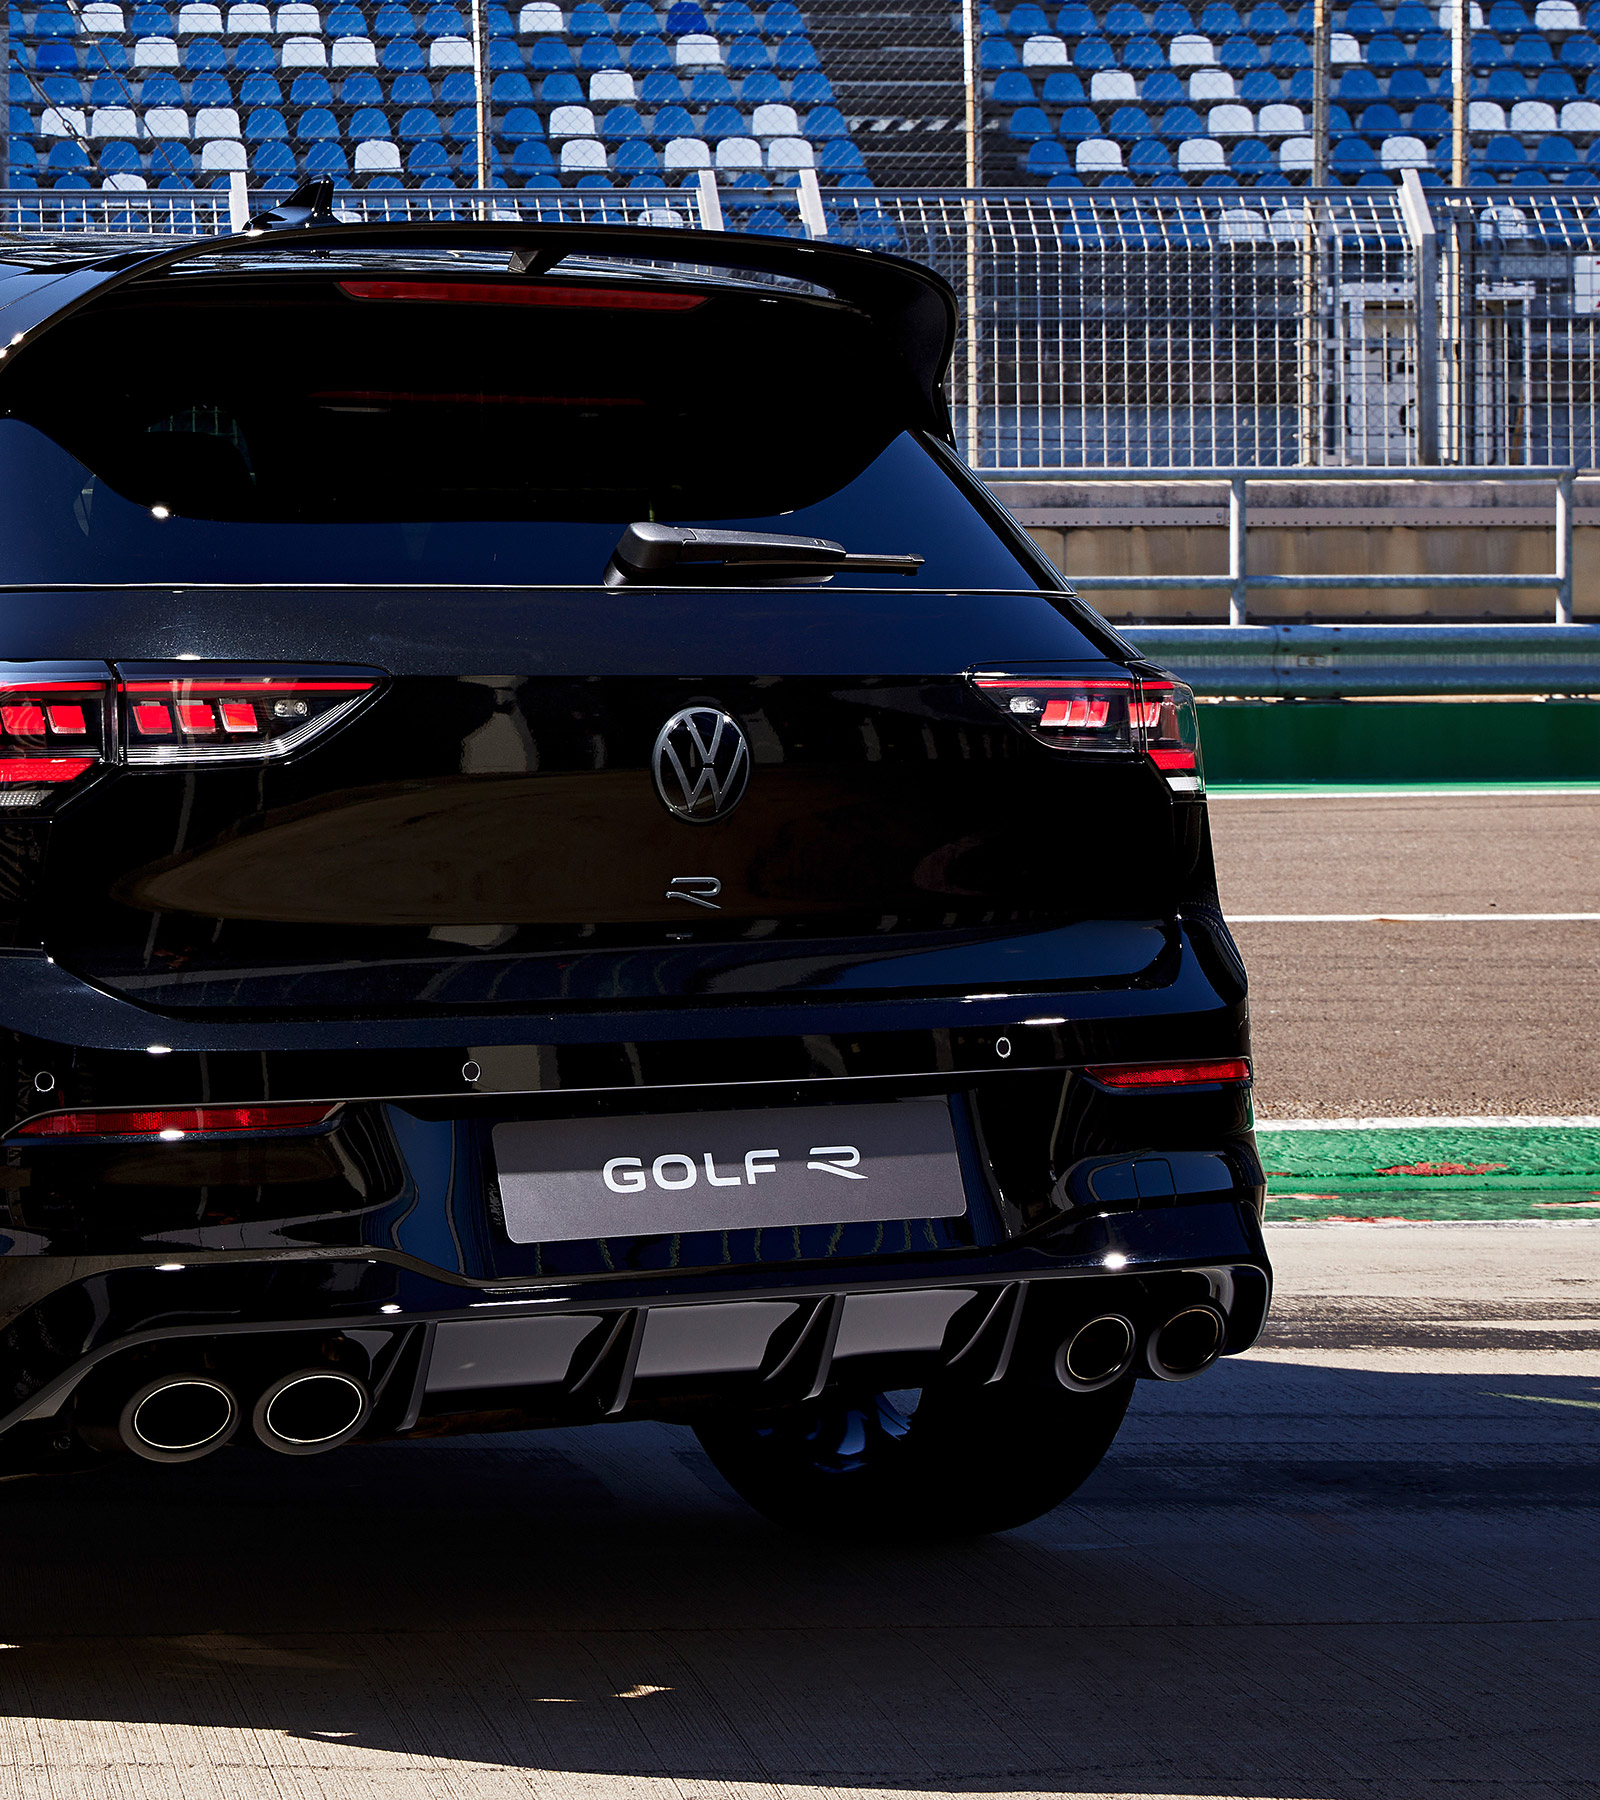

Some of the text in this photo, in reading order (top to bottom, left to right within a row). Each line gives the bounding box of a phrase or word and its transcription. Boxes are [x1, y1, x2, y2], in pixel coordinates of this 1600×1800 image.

[665, 876, 722, 909] R
[603, 1145, 869, 1194] GOLF R
